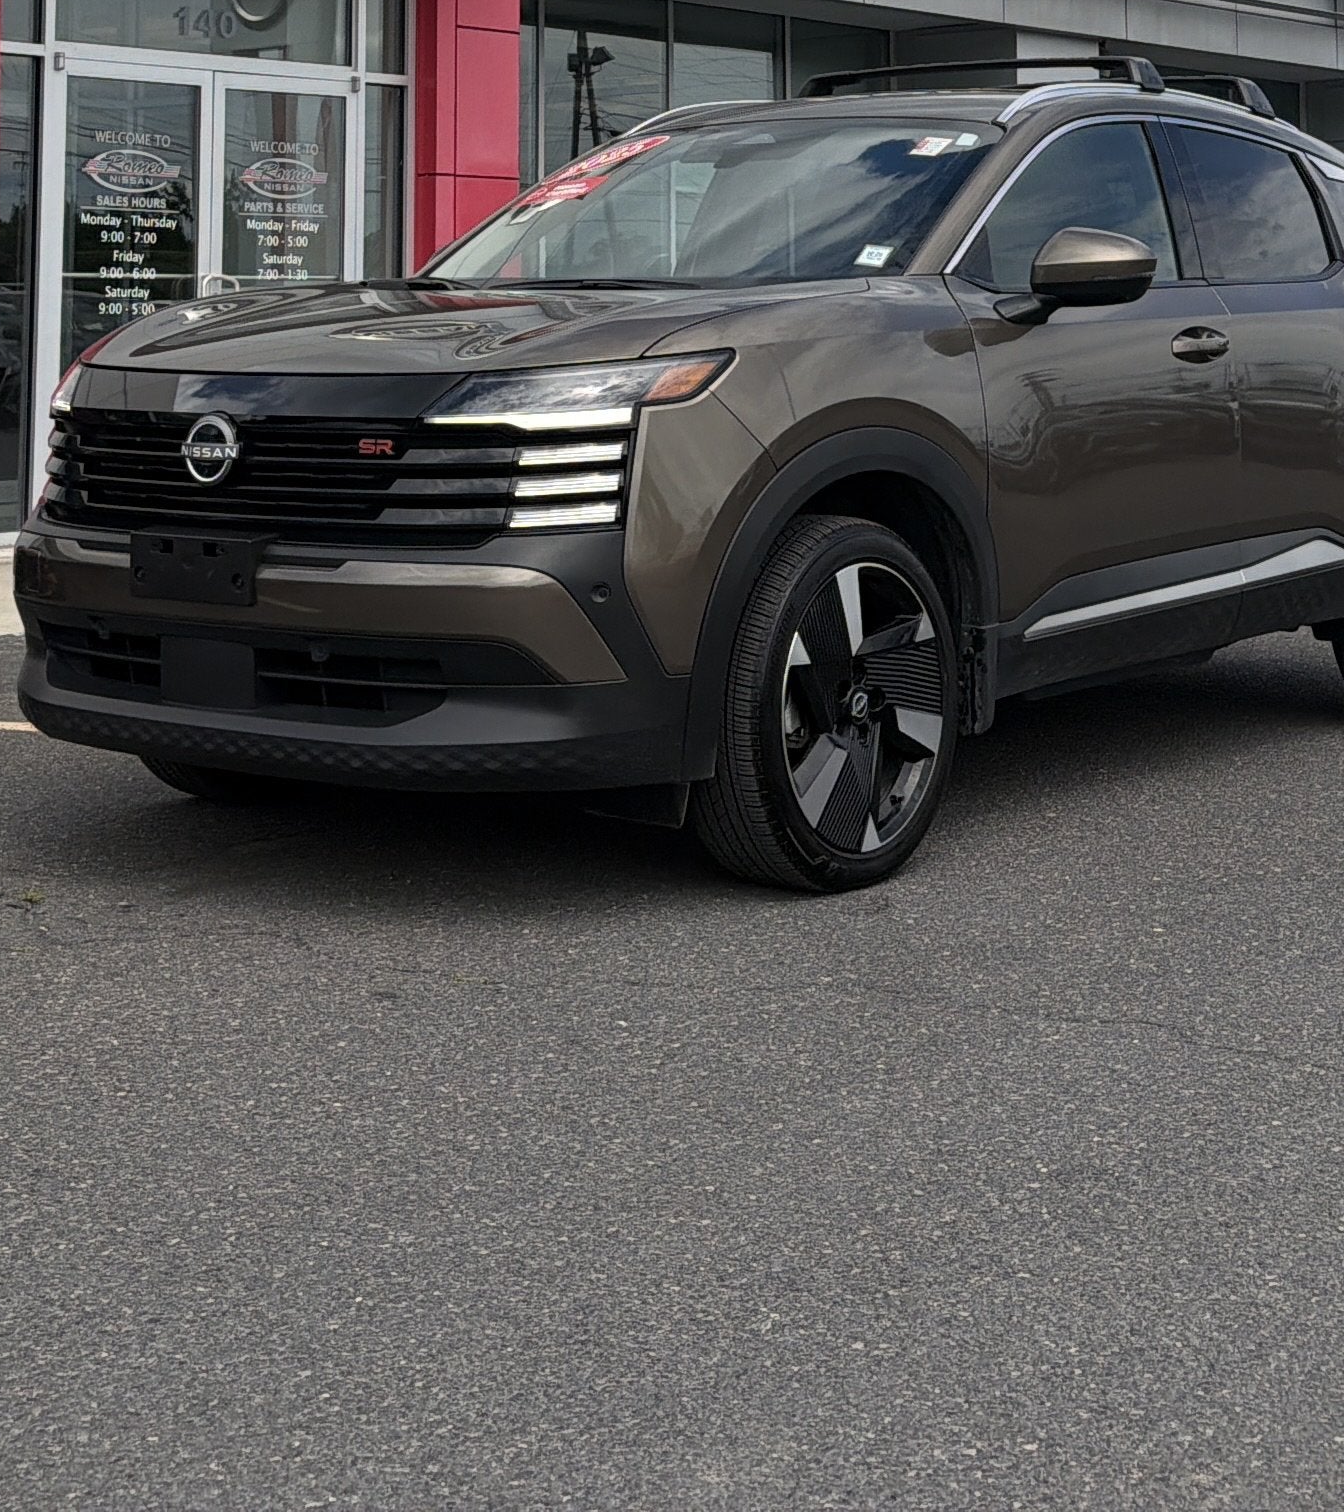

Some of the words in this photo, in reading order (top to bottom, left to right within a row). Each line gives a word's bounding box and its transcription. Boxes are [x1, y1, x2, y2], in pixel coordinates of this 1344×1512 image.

[172, 5, 233, 39] 140
[95, 130, 150, 146] WELCOME
[154, 134, 171, 148] TO
[250, 140, 301, 155] WELCOME
[303, 143, 319, 156] TO
[100, 151, 165, 175] Romeo
[109, 175, 154, 186] NISSAN
[263, 183, 305, 192] NISSAN
[96, 194, 129, 207] SALES
[131, 196, 167, 209] HOURS
[244, 201, 274, 213] PARTS
[276, 202, 284, 213] &
[285, 202, 325, 215] SERVICE
[80, 212, 122, 228] Monday
[130, 214, 178, 231] Thursday
[246, 218, 284, 233] Monday
[291, 220, 320, 234] Friday
[100, 230, 125, 243] 9:00
[133, 231, 158, 244] 7:00
[257, 235, 280, 247] 7:00
[287, 236, 309, 248] 5:00
[112, 249, 145, 265] Friday
[262, 253, 304, 267] Saturday
[99, 266, 124, 279] 9:00
[132, 267, 157, 280] 6:00
[257, 269, 279, 281] 7:00
[288, 269, 309, 281] 1:30
[104, 285, 151, 301] Saturday
[98, 302, 123, 315] 9:00
[131, 303, 156, 316] 5:00
[181, 443, 239, 459] NISSAN
[358, 438, 394, 455] SR
